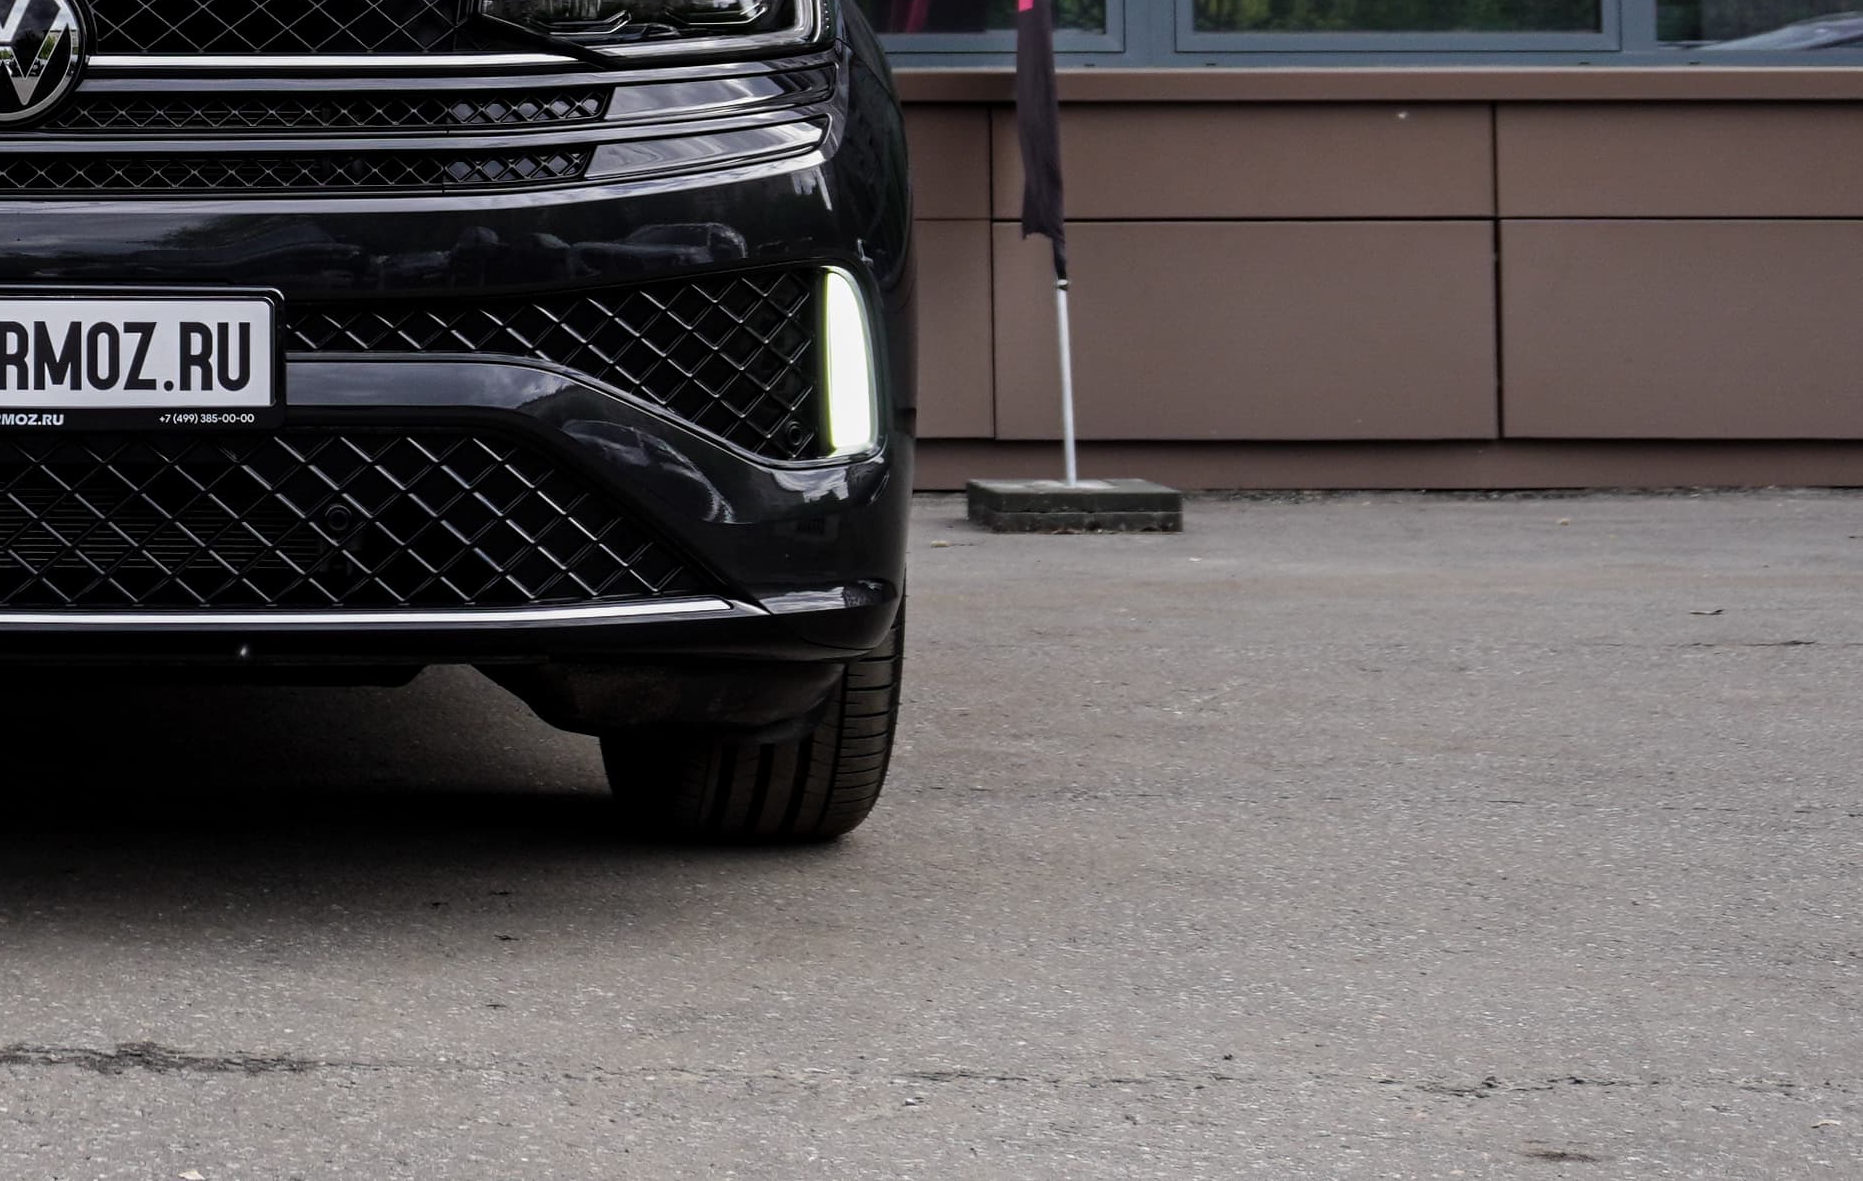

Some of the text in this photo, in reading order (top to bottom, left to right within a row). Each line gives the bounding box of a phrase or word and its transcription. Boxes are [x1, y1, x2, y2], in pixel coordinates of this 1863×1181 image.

[159, 412, 255, 424] +7 (499) 385-00-00
